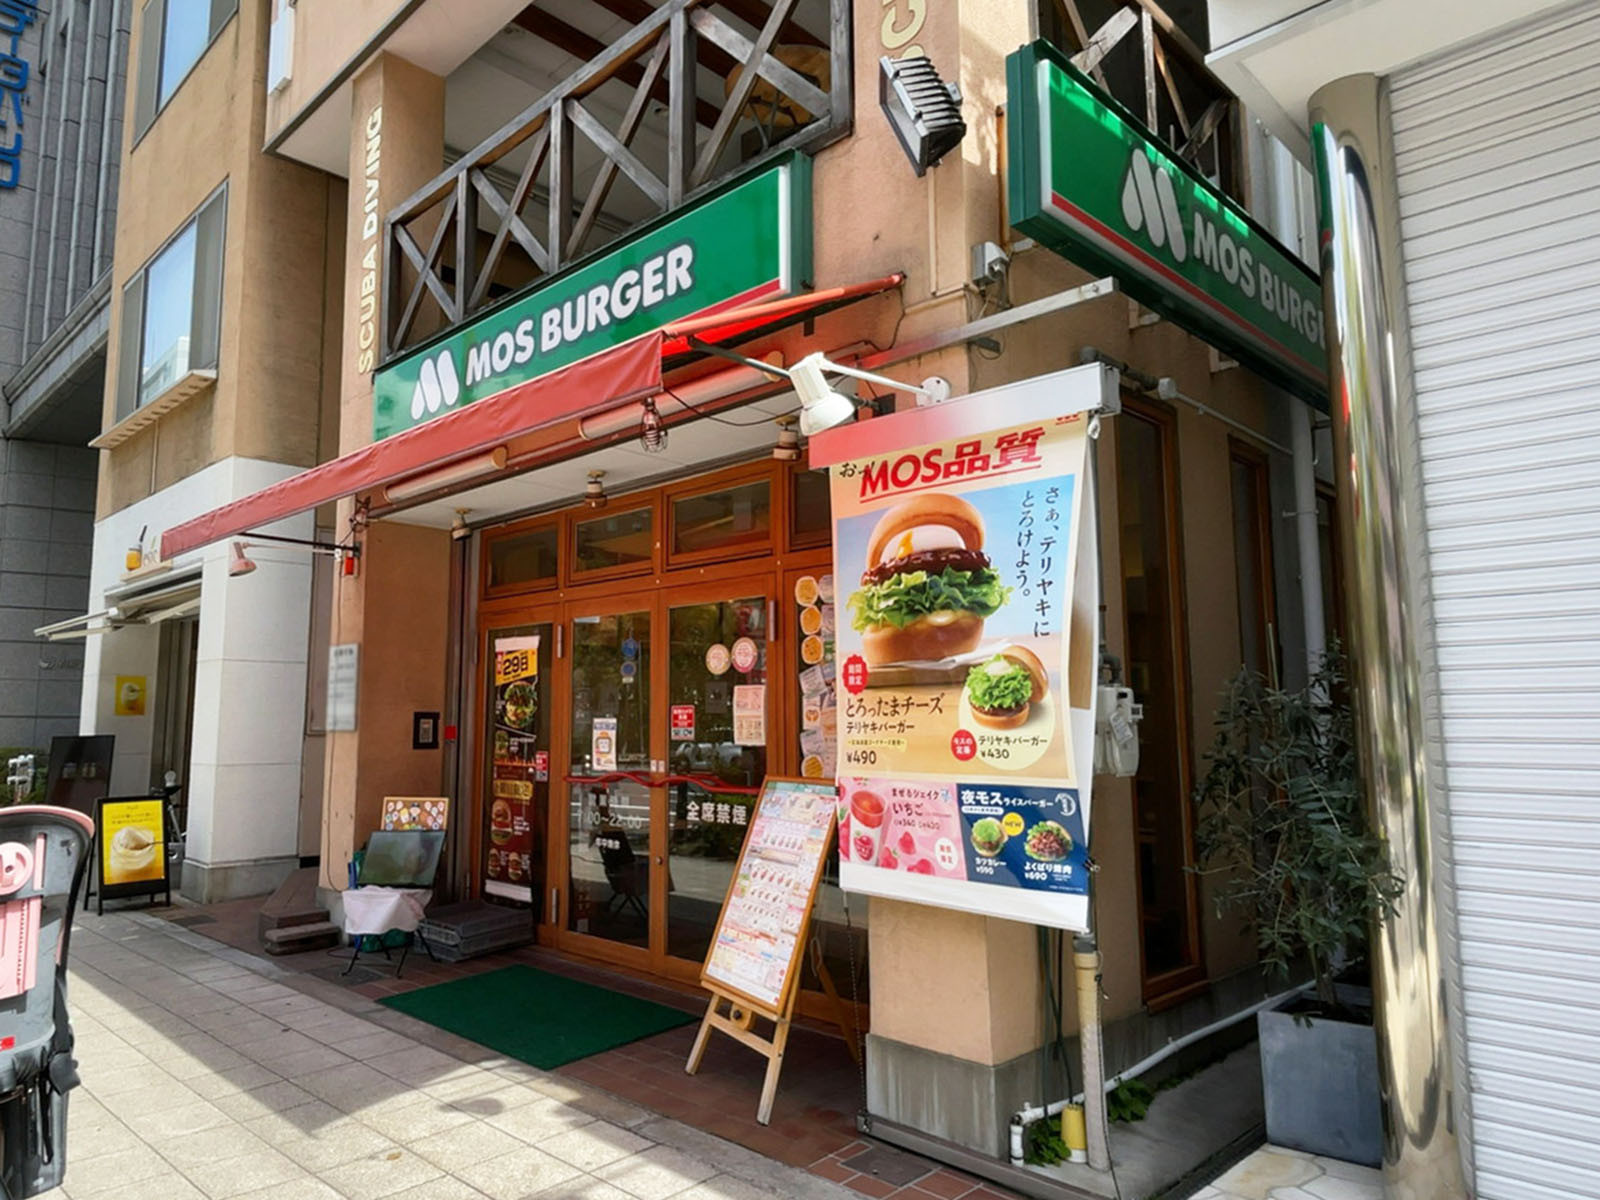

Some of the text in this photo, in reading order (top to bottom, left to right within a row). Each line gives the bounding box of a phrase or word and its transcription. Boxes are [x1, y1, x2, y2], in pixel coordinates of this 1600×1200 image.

[358, 106, 382, 374] SCUBA DIVING
[1194, 211, 1256, 299] MOS
[466, 319, 535, 387] MOS
[541, 244, 693, 353] BURGER
[859, 427, 1046, 498] MOS品質
[1016, 490, 1035, 597] とろけよう。
[845, 692, 946, 718] とろったまチーズ
[845, 719, 915, 735] テリヤキバーガー
[979, 735, 1048, 747] テリヤキバーガー
[981, 748, 1010, 760] ¥430
[845, 750, 877, 765] ¥490
[686, 800, 747, 826] 全席禁煙
[892, 803, 924, 817] いちご
